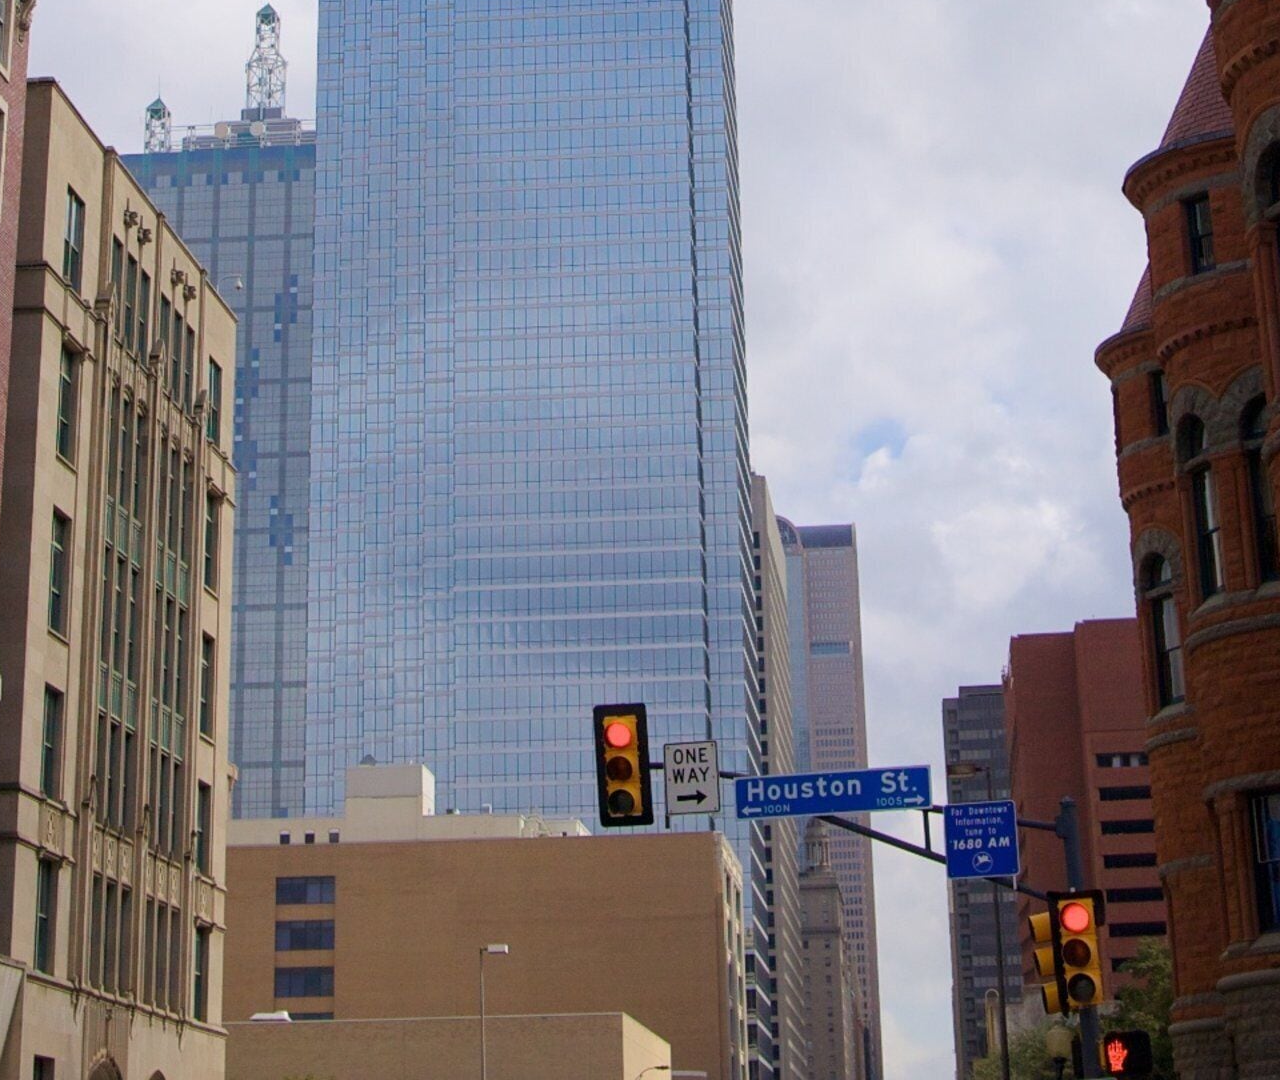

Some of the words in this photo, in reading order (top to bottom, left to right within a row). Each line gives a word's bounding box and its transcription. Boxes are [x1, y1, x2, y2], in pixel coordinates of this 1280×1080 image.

[673, 747, 708, 765] ONE
[672, 767, 710, 784] WAY
[747, 779, 862, 802] Houston
[880, 771, 918, 793] St.
[876, 796, 903, 806] 100S
[763, 804, 791, 813] 100N
[951, 808, 963, 816] For
[968, 806, 1008, 816] Downtown
[965, 828, 983, 836] tune
[988, 827, 997, 835] to
[953, 838, 983, 850] 1680
[988, 836, 1010, 848] AM
